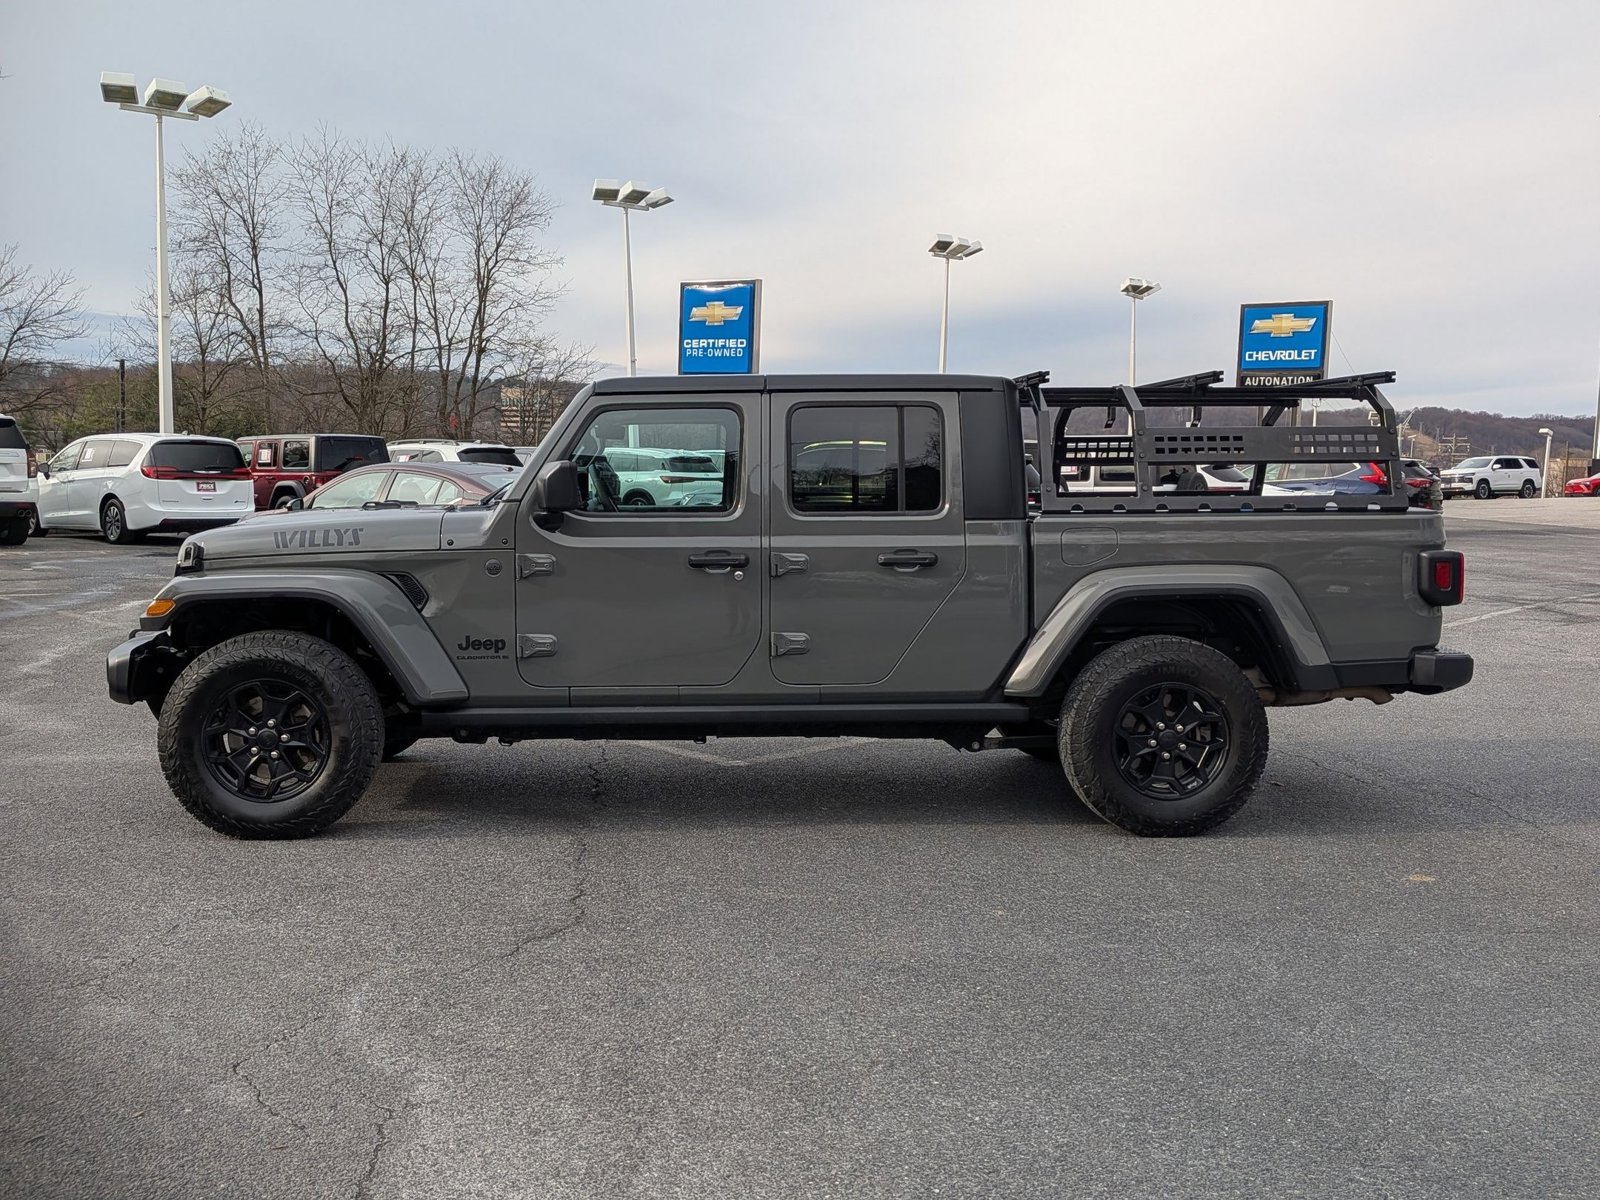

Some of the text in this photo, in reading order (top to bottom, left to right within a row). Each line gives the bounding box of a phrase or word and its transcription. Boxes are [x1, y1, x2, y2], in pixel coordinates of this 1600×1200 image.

[684, 339, 746, 348] CERTIFIED
[686, 348, 743, 357] PRE-OWNED
[1245, 350, 1317, 361] CHEVROLET
[1245, 376, 1314, 386] AUTONATION
[273, 528, 364, 549] WILLYS
[457, 635, 506, 653] Jeep
